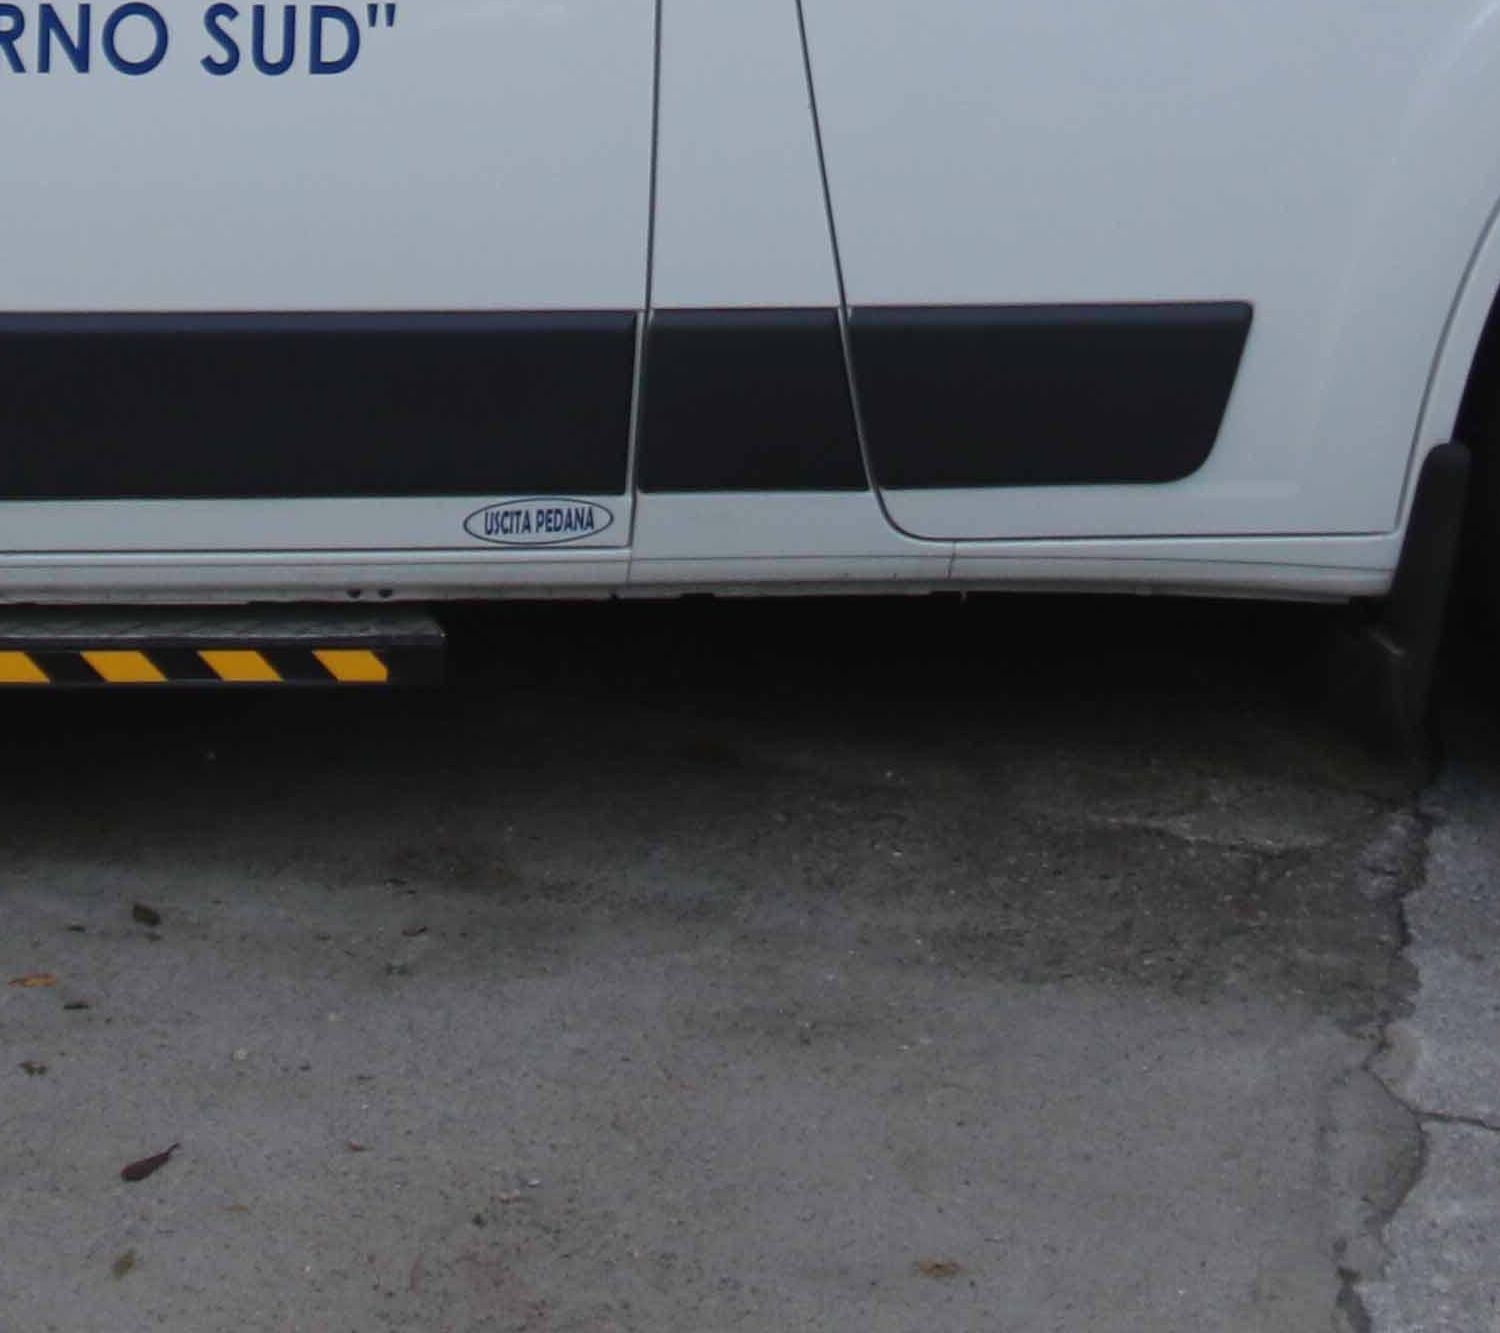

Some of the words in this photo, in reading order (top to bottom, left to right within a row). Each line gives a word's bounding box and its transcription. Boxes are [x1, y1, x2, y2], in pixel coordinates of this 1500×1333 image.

[198, 1, 397, 76] SUD"
[484, 511, 531, 535] USCITA
[537, 508, 595, 532] PEDANA
